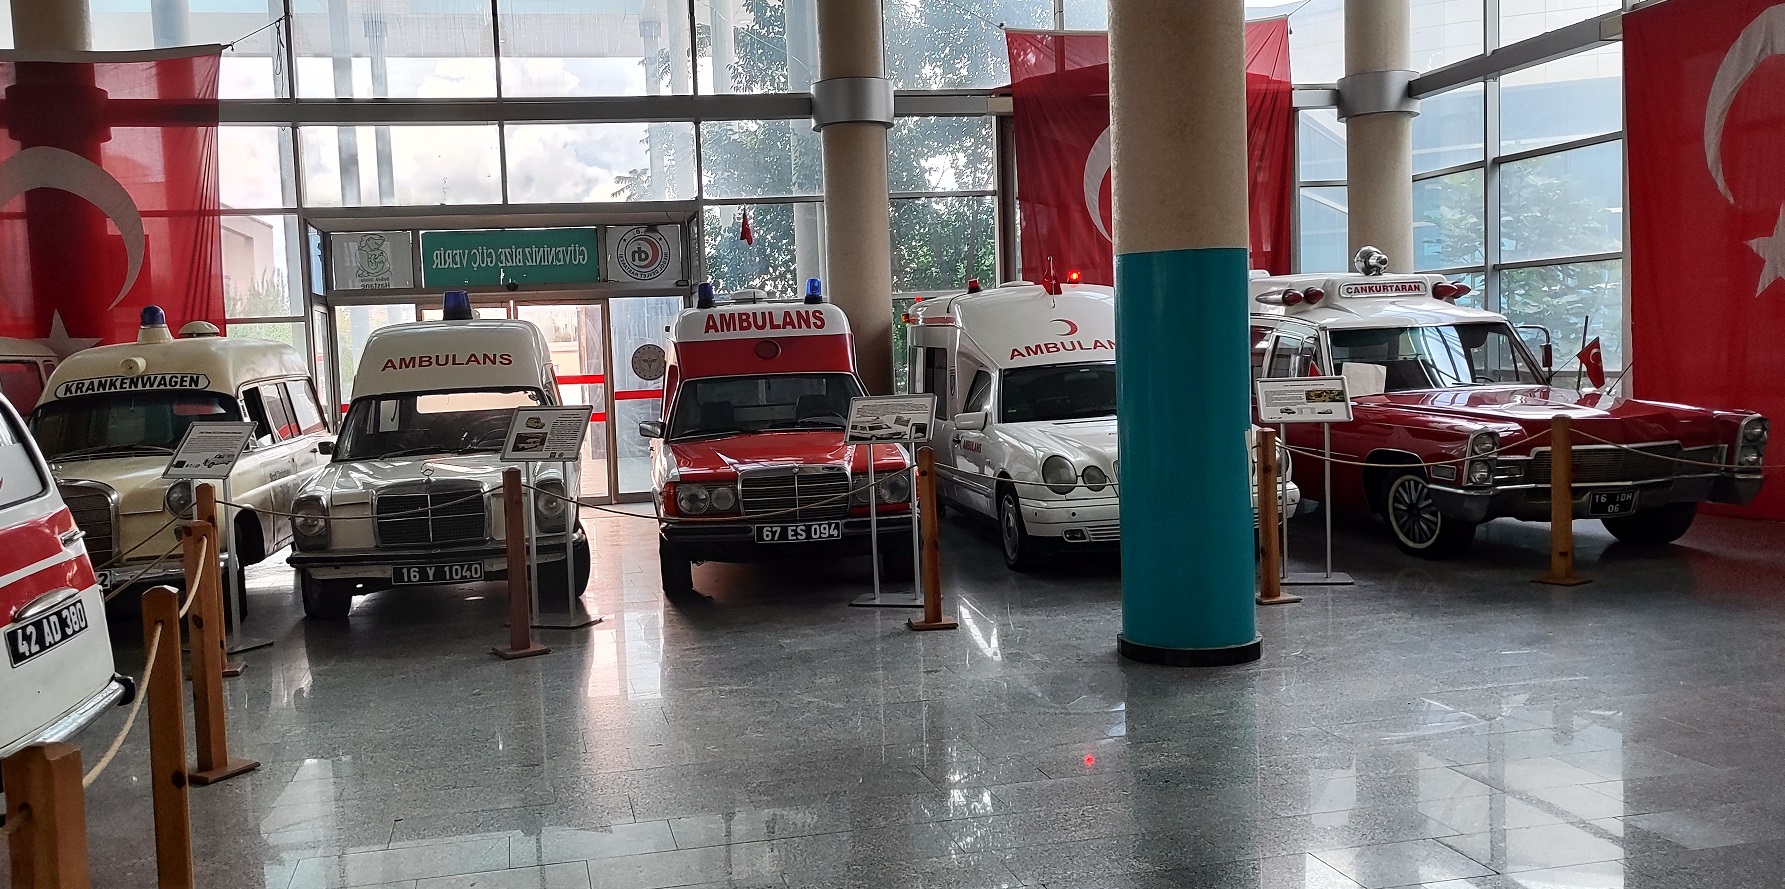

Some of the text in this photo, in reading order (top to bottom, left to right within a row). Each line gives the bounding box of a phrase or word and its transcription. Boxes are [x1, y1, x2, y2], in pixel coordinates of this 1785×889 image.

[1346, 284, 1420, 294] CANKURTARAN
[704, 310, 826, 334] AMBULANS
[1010, 339, 1115, 361] AMBULAN
[381, 353, 513, 372] AMBULANS
[63, 375, 200, 396] KRANKENWAGEN
[1595, 494, 1607, 503] 16
[1607, 503, 1620, 513] 06
[763, 523, 838, 541] 67 ES 094
[402, 564, 481, 582] 16 Y 1040
[17, 602, 86, 657] 42 AD 380
